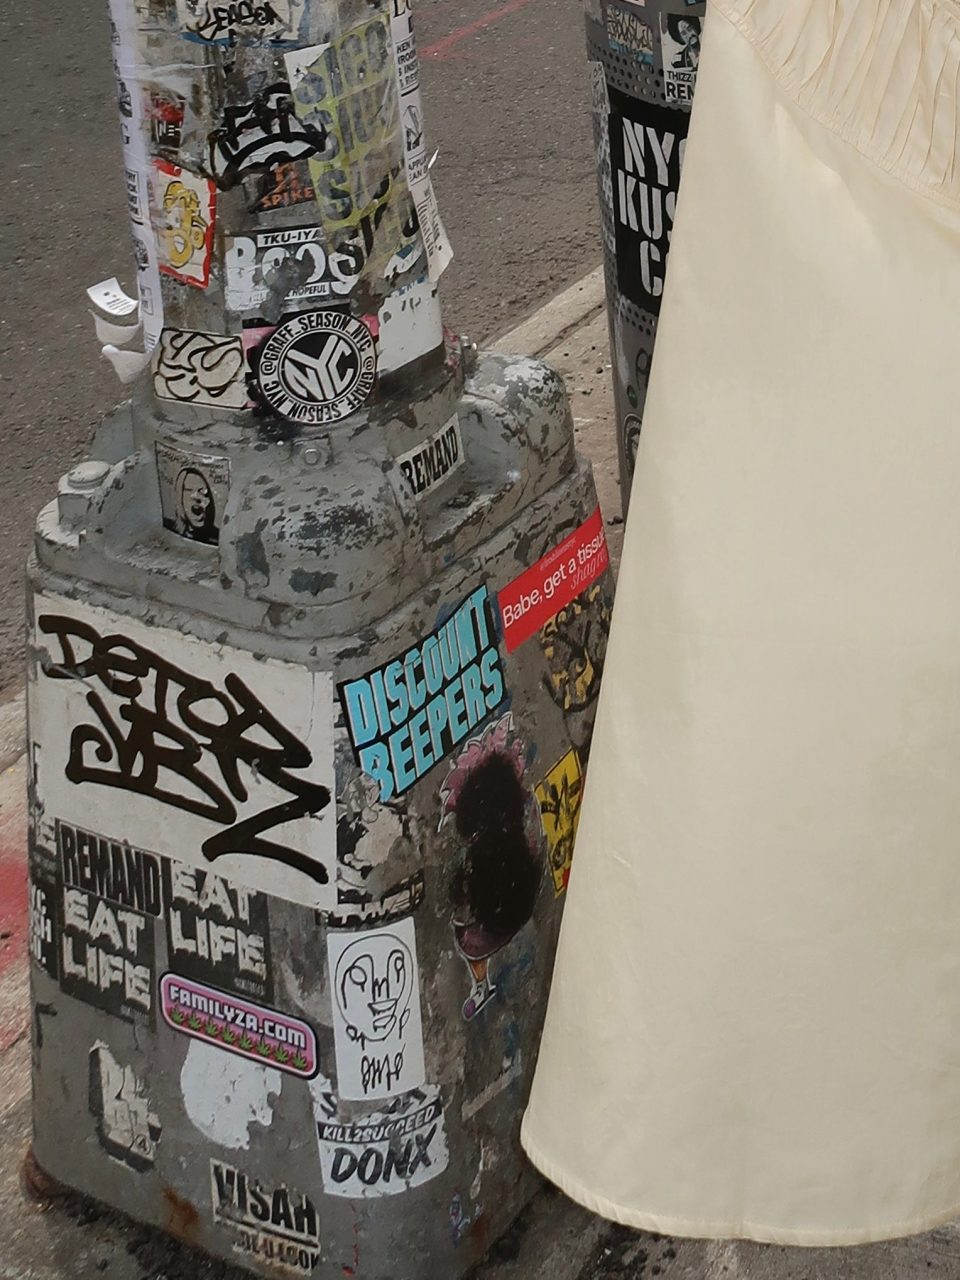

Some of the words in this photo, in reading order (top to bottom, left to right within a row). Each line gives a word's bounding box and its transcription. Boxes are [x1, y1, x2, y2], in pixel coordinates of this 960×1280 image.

[666, 70, 693, 83] THIZZ
[284, 334, 355, 402] NYC
[400, 425, 458, 495] REMAND
[502, 588, 543, 629] Babe,
[543, 563, 568, 599] get
[568, 557, 576, 574] a
[344, 584, 490, 747] DISCOUNT
[359, 646, 503, 803] BEEPERS
[60, 821, 164, 919] REMAND
[170, 859, 258, 925] EAT
[64, 886, 145, 958] EAT
[169, 907, 268, 981] LIFE
[62, 931, 150, 1010] LIFE
[330, 1122, 438, 1186] DONX
